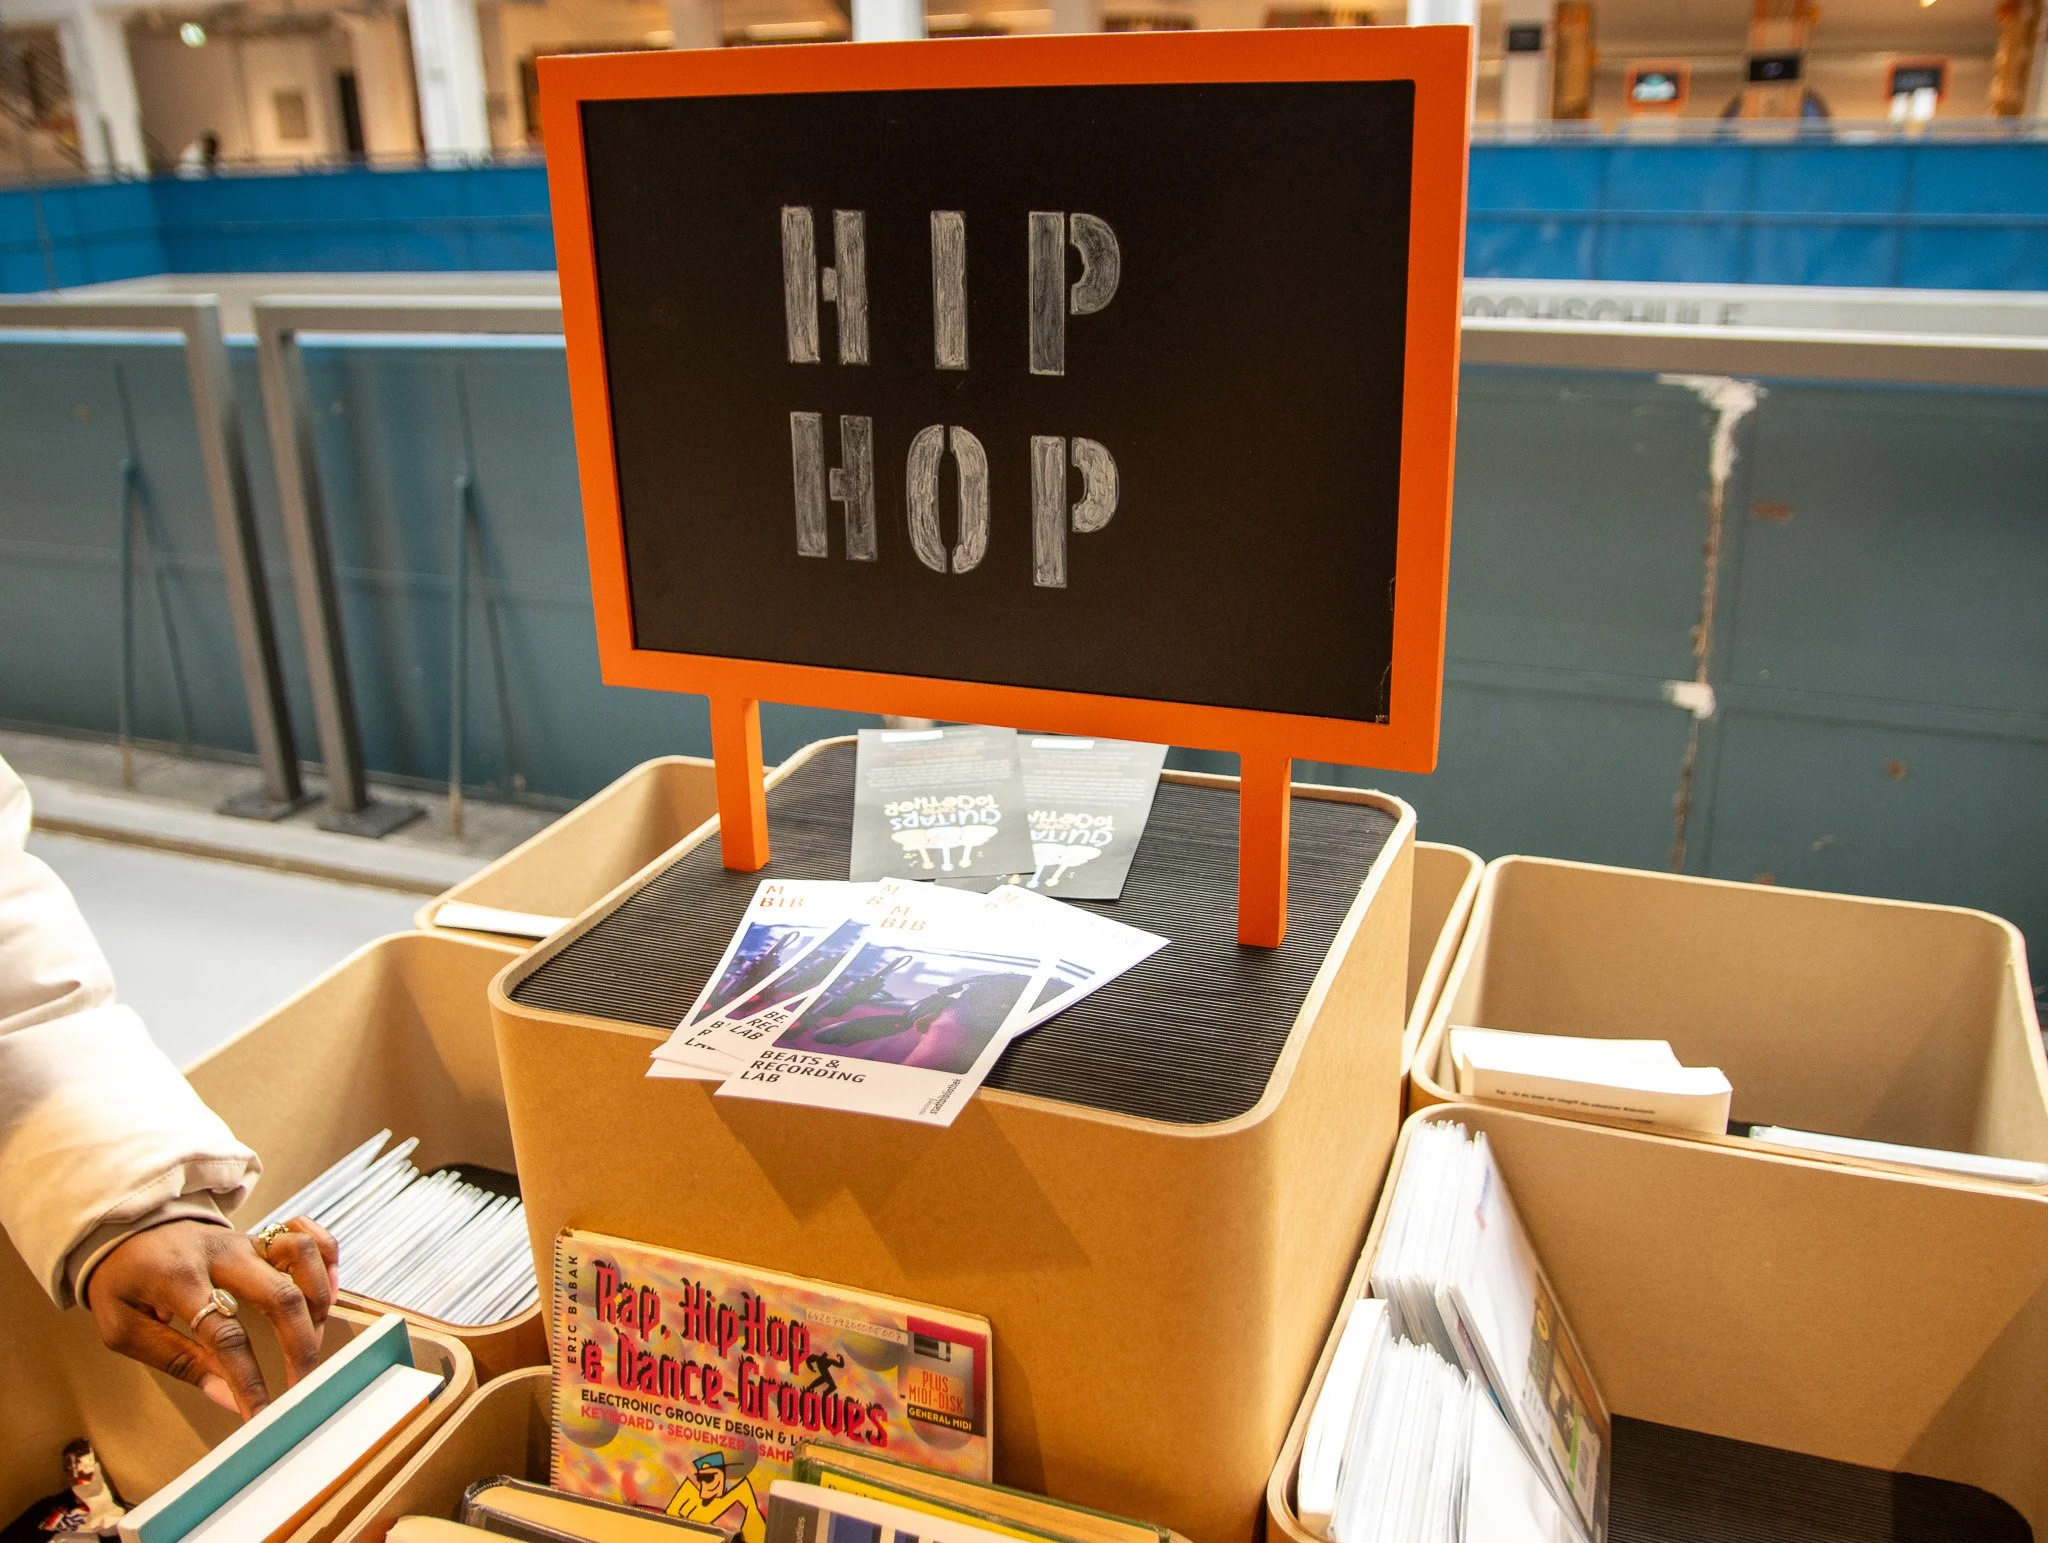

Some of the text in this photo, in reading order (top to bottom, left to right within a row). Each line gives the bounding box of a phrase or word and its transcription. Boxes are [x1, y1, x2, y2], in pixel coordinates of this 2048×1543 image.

[781, 205, 1121, 376] HIP
[790, 411, 1120, 589] HOP
[729, 1024, 764, 1040] LAB
[740, 1070, 781, 1083] LAB
[750, 1060, 866, 1083] RECORDING
[760, 1050, 840, 1069] BEATS &
[567, 1255, 578, 1364] ERIC BABAK
[592, 1259, 671, 1342] Rap,
[581, 1327, 888, 1448] & Dance-Grooves
[908, 1385, 964, 1414] MIDI-DISK
[922, 1371, 949, 1393] PLUS
[581, 1389, 662, 1416] ELECTRONIC
[665, 1406, 721, 1430] GROOVE
[725, 1420, 774, 1441] DESIGN
[778, 1431, 786, 1444] &
[581, 1405, 655, 1431] KEYBOARD
[667, 1424, 745, 1451] SEQUENZER
[908, 1407, 972, 1431] GENERAL MIDI
